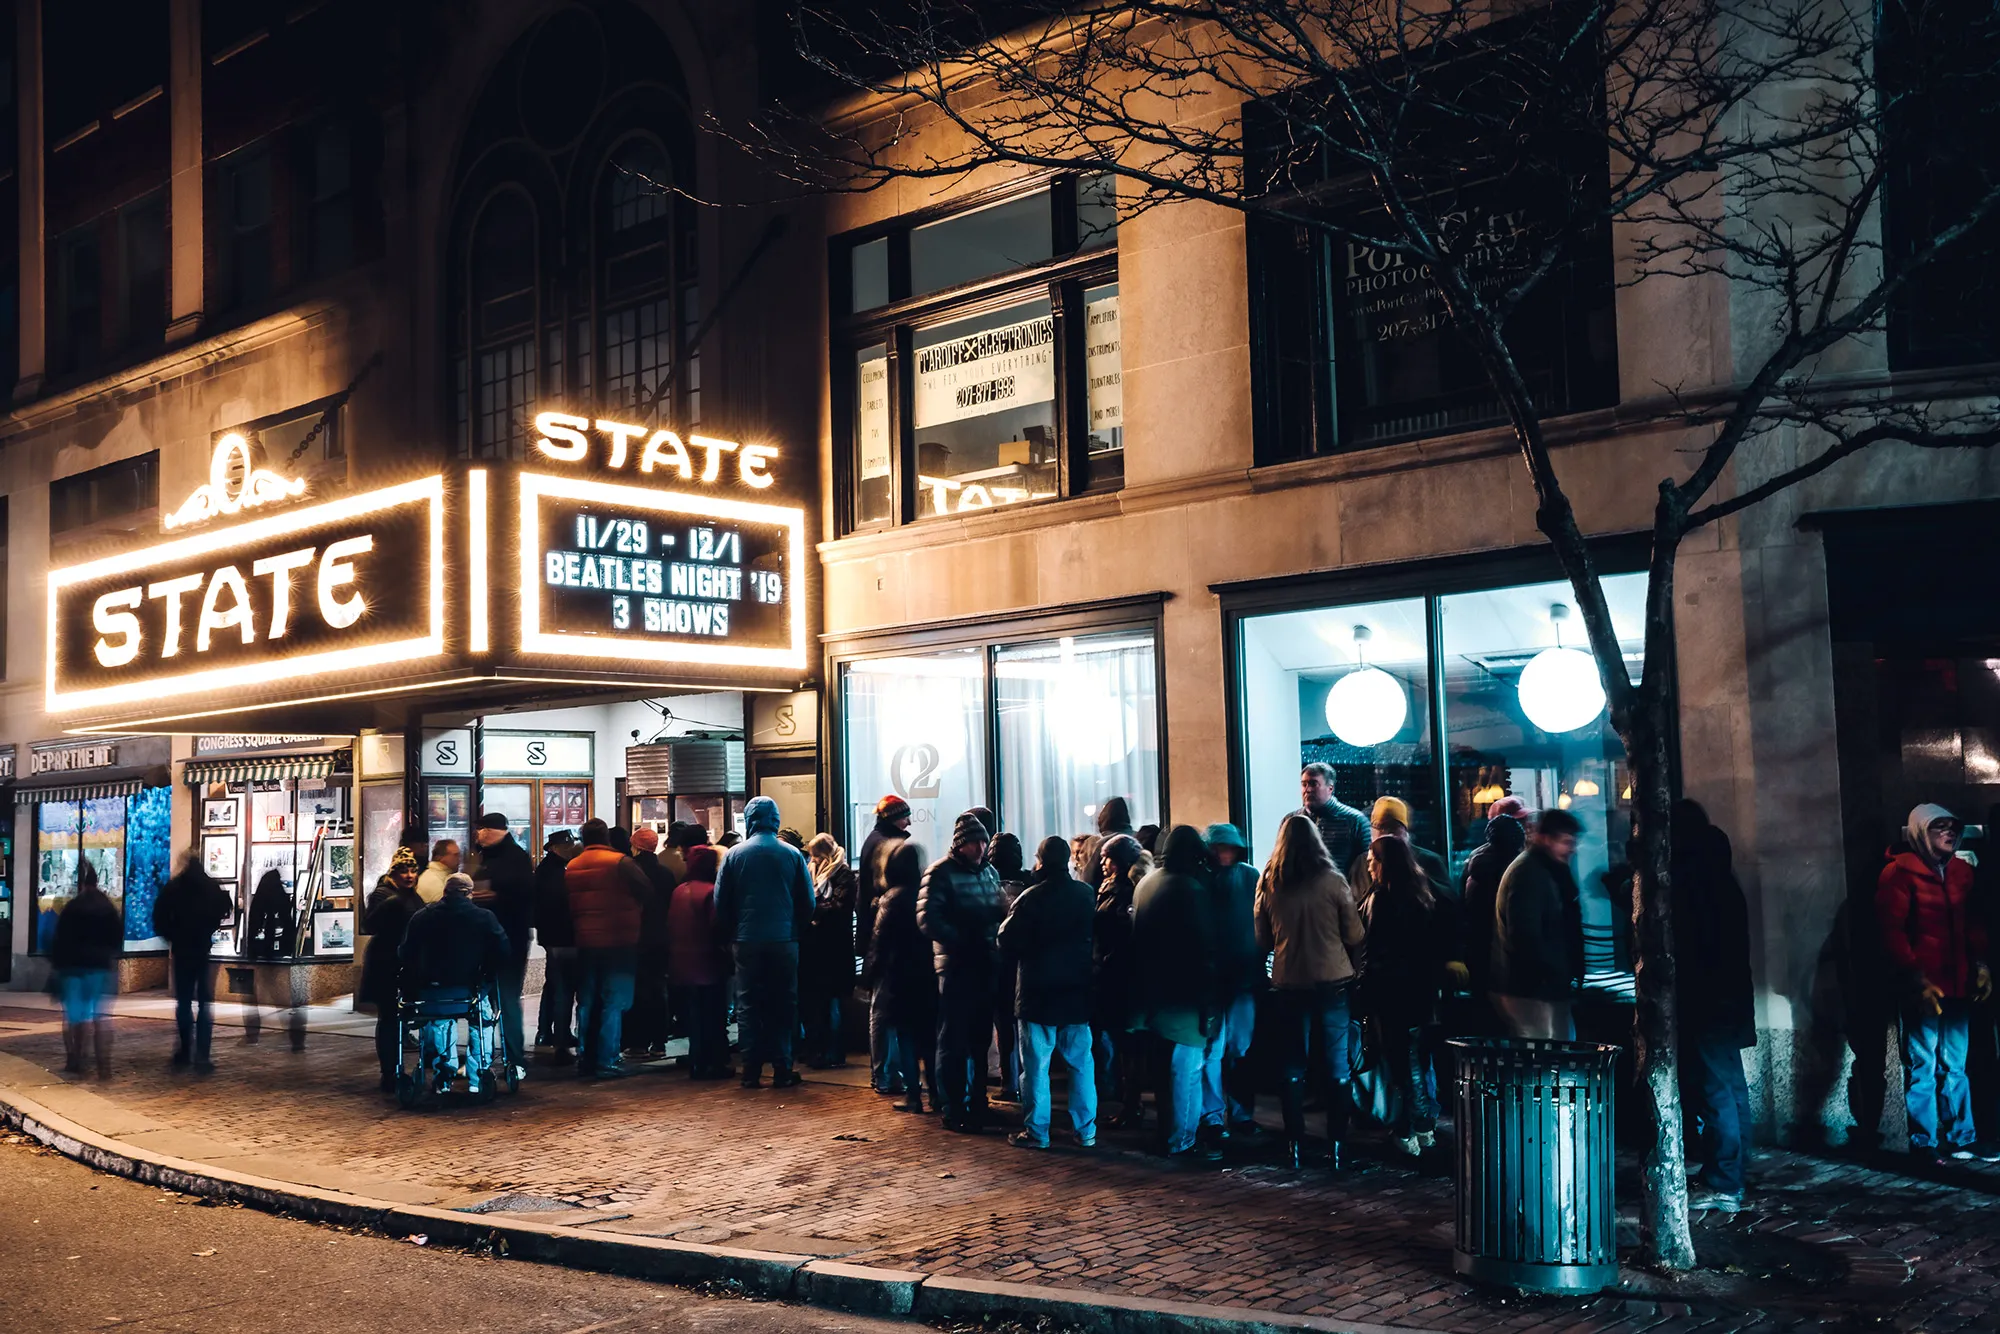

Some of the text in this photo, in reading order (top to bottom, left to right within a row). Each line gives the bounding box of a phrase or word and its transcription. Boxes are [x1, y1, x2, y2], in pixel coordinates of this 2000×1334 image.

[920, 319, 1053, 374] TARDIFF ELECTRONICS
[1088, 341, 1120, 358] INSTRUMENTS
[956, 376, 1015, 409] 207-877-1998
[1091, 373, 1120, 389] TURNTABLES
[1094, 409, 1103, 421] AND
[535, 411, 779, 489] STATE
[576, 514, 647, 553] 11/29
[689, 528, 740, 562] 12/1
[546, 551, 782, 603] BEATLES NIGHT '19
[93, 533, 374, 668] STATE
[613, 596, 728, 636] 3 SHOWS
[775, 704, 796, 736] S
[198, 735, 243, 751] CONGRESS
[245, 735, 281, 748] SQUARE
[436, 740, 458, 766] S
[526, 741, 547, 766] S
[31, 745, 113, 774] DEPARTMENT
[912, 808, 936, 823] LON
